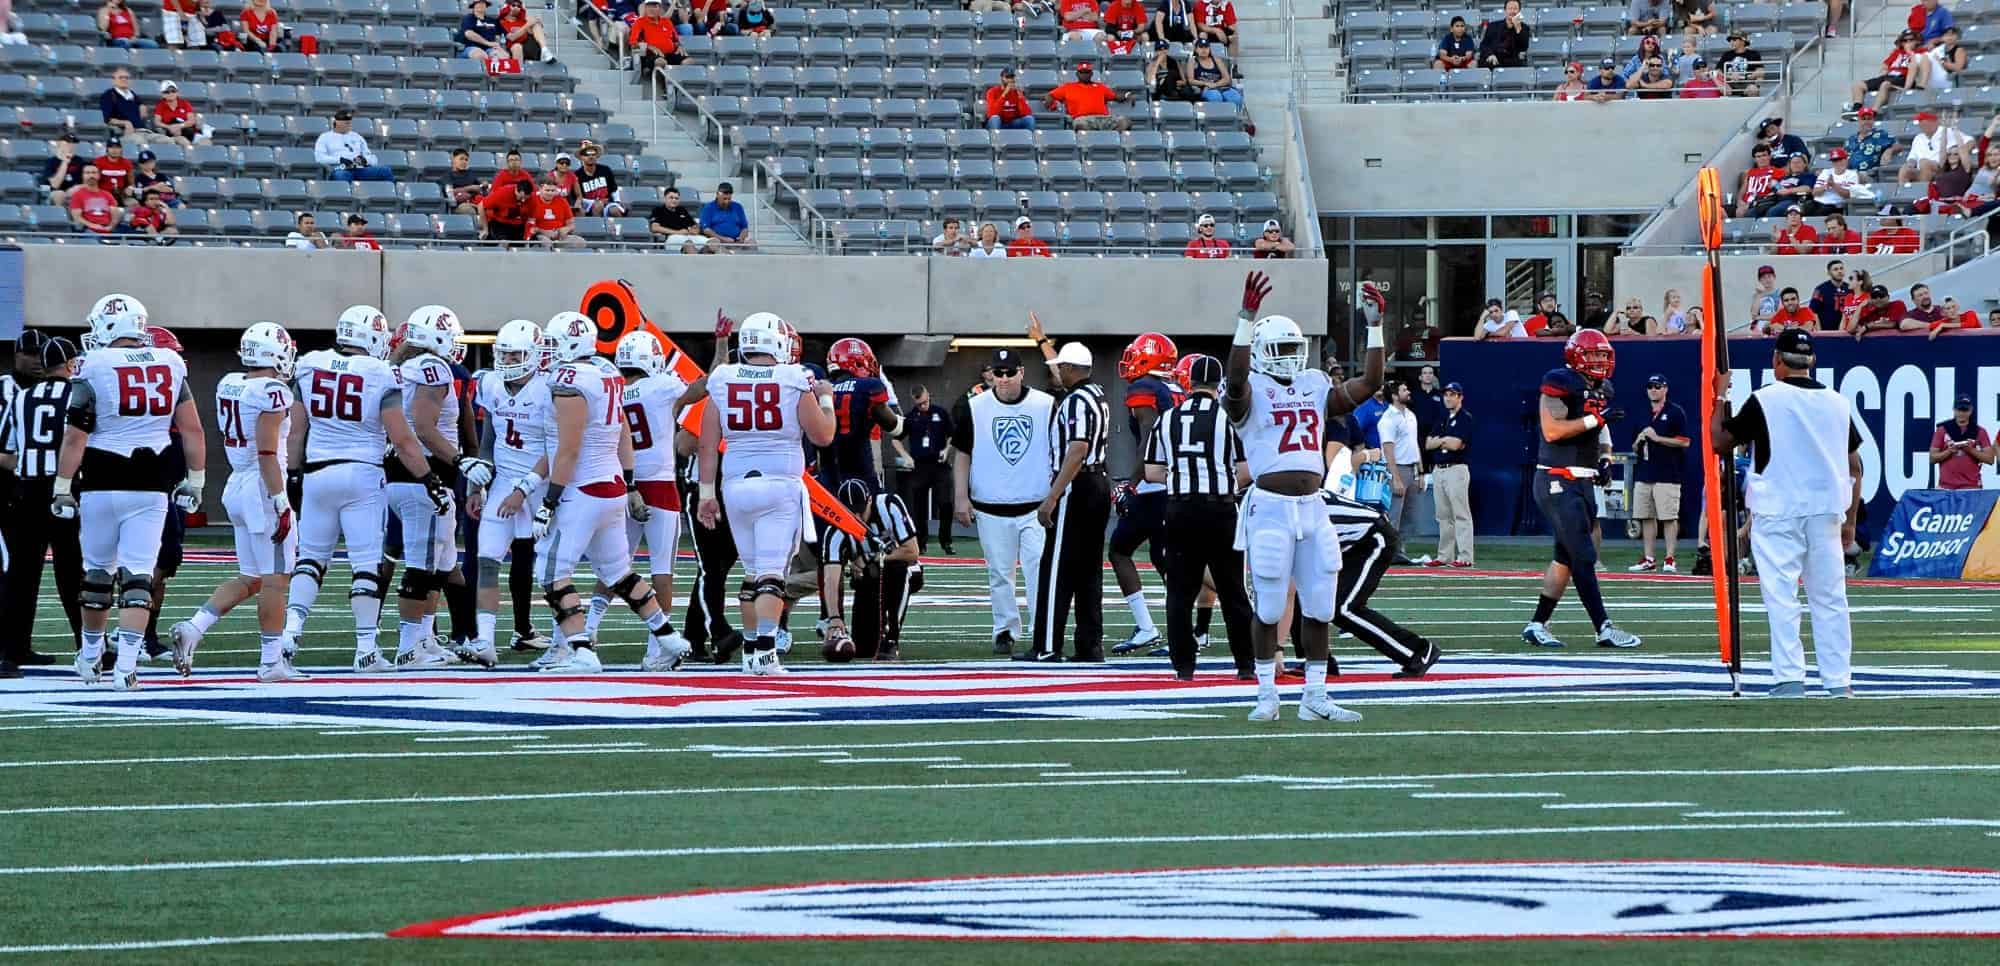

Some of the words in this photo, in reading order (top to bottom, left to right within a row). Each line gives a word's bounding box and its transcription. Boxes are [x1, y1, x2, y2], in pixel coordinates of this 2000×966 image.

[112, 364, 172, 416] 63
[423, 366, 440, 384] 61
[556, 368, 577, 385] 73
[267, 390, 286, 409] 21
[310, 369, 364, 422] 56
[623, 386, 641, 401] ARKS
[727, 382, 784, 432] 58
[32, 404, 56, 444] C
[220, 398, 248, 447] 21
[505, 418, 524, 450] 4
[1178, 414, 1206, 452] L
[1269, 408, 1320, 454] 23
[1005, 440, 1021, 455] 12
[1910, 506, 1974, 533] Game
[1881, 532, 1970, 565] Sponsor
[358, 652, 377, 669] NIKE
